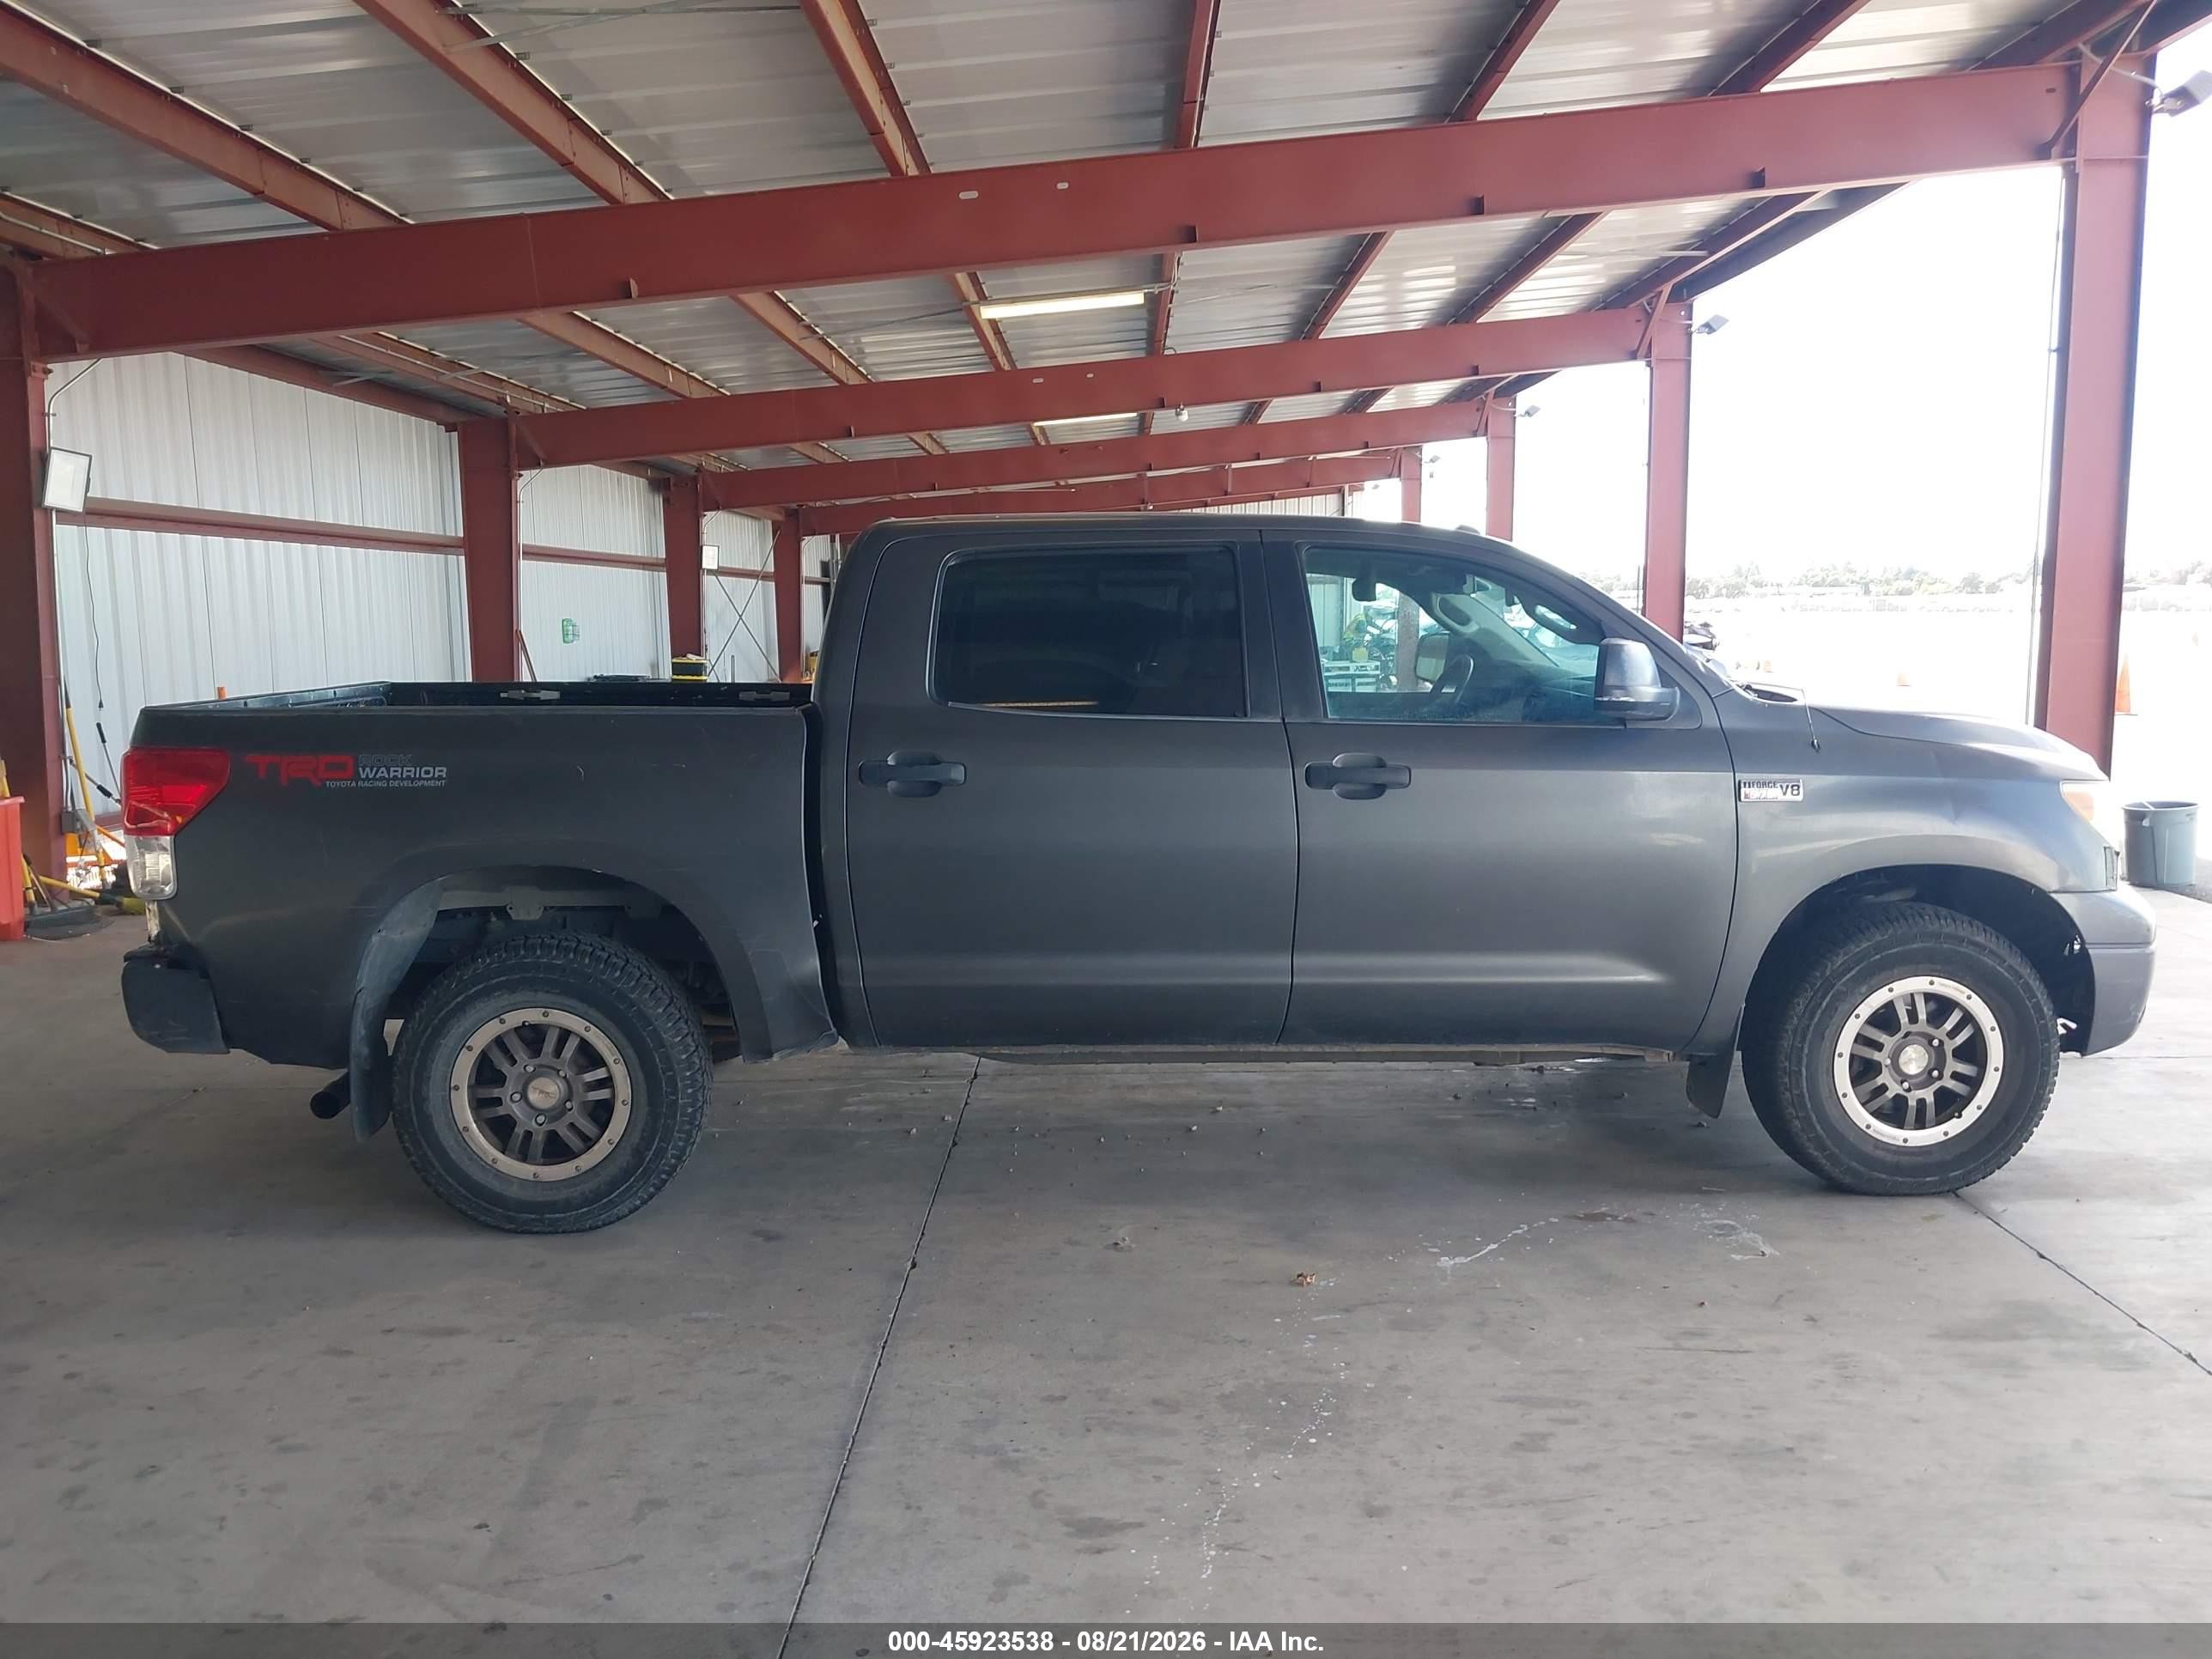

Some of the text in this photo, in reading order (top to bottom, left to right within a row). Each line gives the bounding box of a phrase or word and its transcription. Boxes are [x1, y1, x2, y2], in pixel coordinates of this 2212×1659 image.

[358, 754, 413, 767] ROCK
[246, 755, 355, 787] TRD
[358, 766, 447, 778] WARRIOR
[1778, 784, 1801, 797] V8
